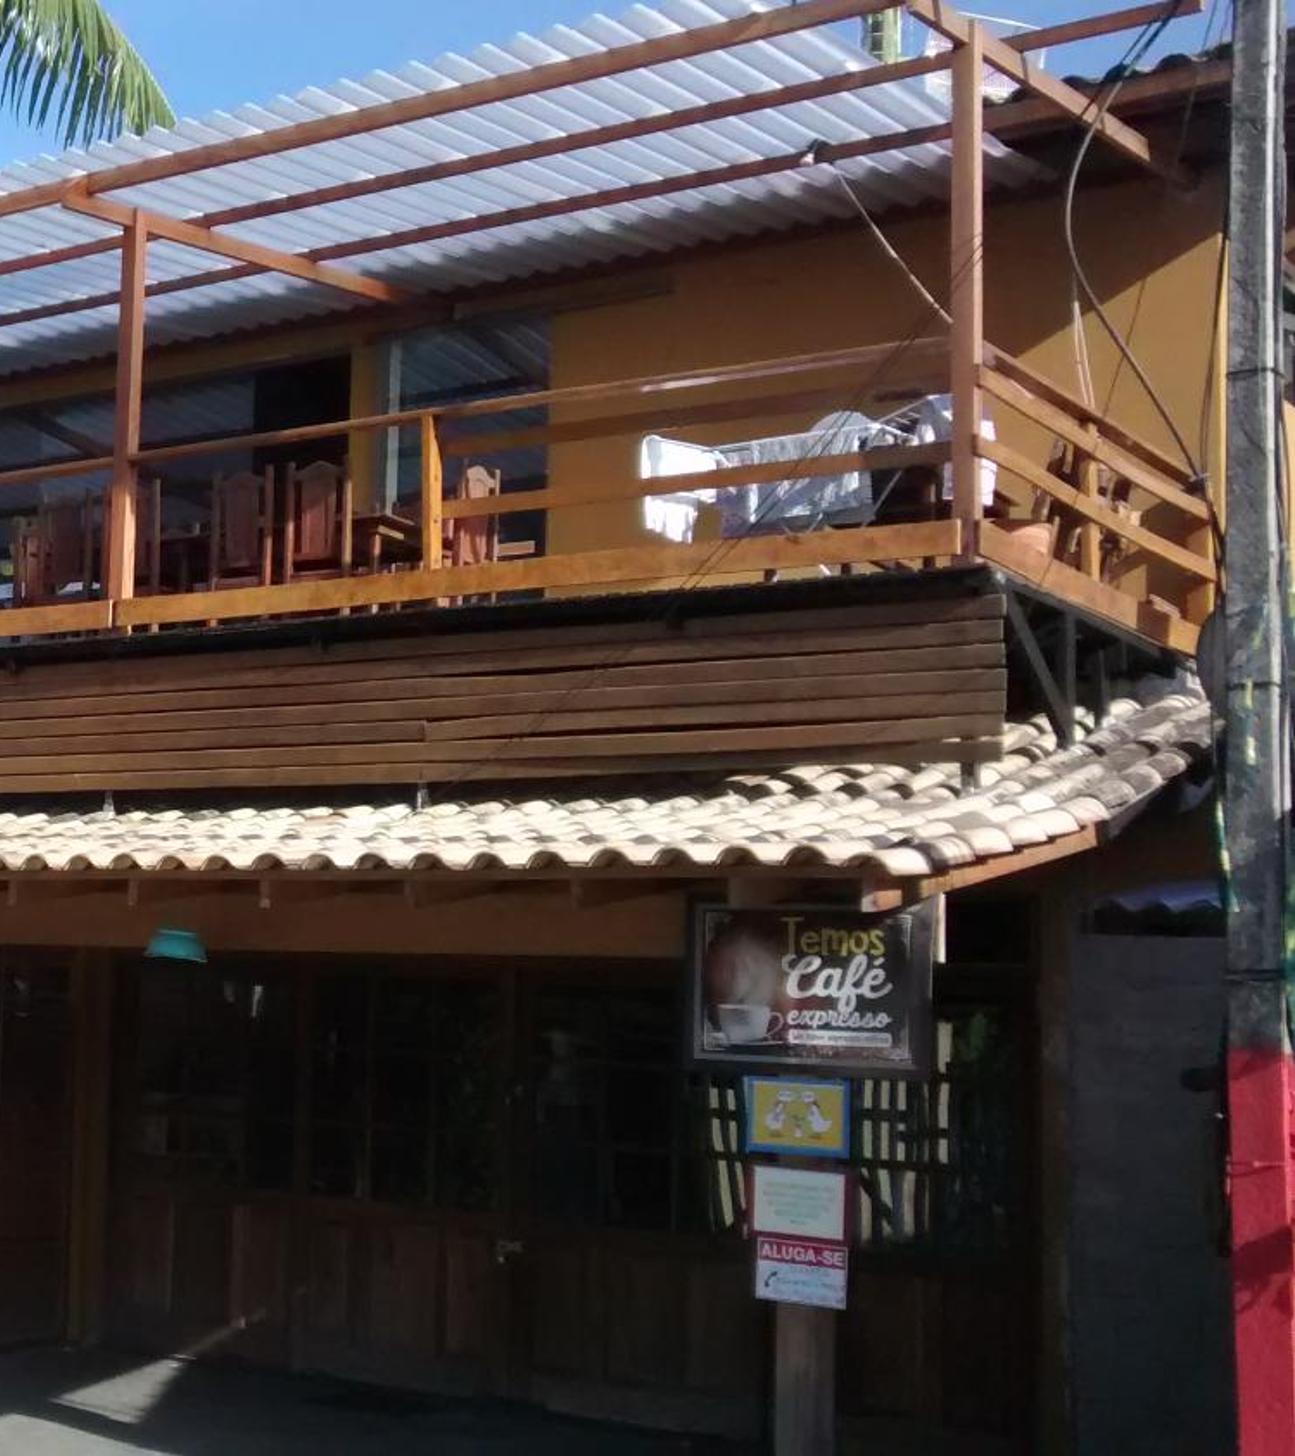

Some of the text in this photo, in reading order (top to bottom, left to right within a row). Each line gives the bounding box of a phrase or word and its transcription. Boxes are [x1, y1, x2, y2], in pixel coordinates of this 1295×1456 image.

[779, 917, 885, 955] Temos
[781, 953, 893, 1013] Café
[787, 1010, 892, 1028] expresso
[761, 1243, 844, 1266] ALUGA-SE
